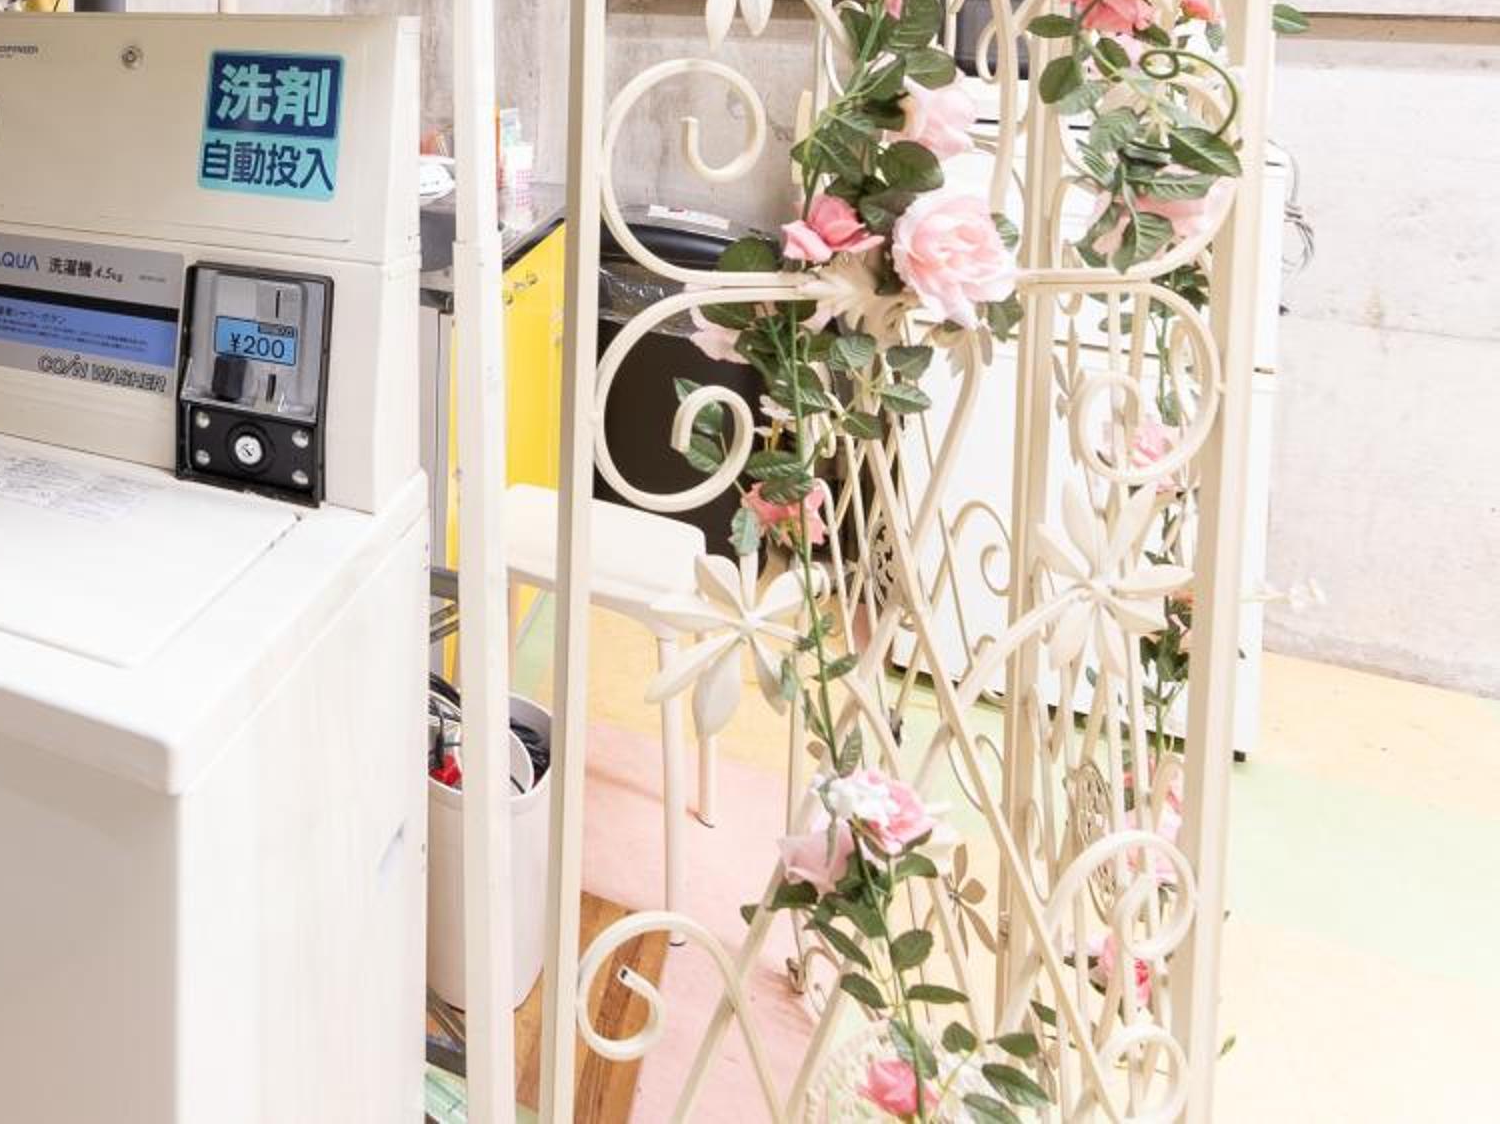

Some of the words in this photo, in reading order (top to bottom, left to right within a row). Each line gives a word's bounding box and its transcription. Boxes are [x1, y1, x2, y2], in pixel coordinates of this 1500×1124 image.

[216, 61, 332, 128] 洗剤
[201, 139, 335, 193] 自動投入
[48, 257, 93, 280] 洗濯機
[229, 331, 286, 359] ¥200
[37, 353, 89, 380] COIN
[91, 363, 167, 393] WASHER
